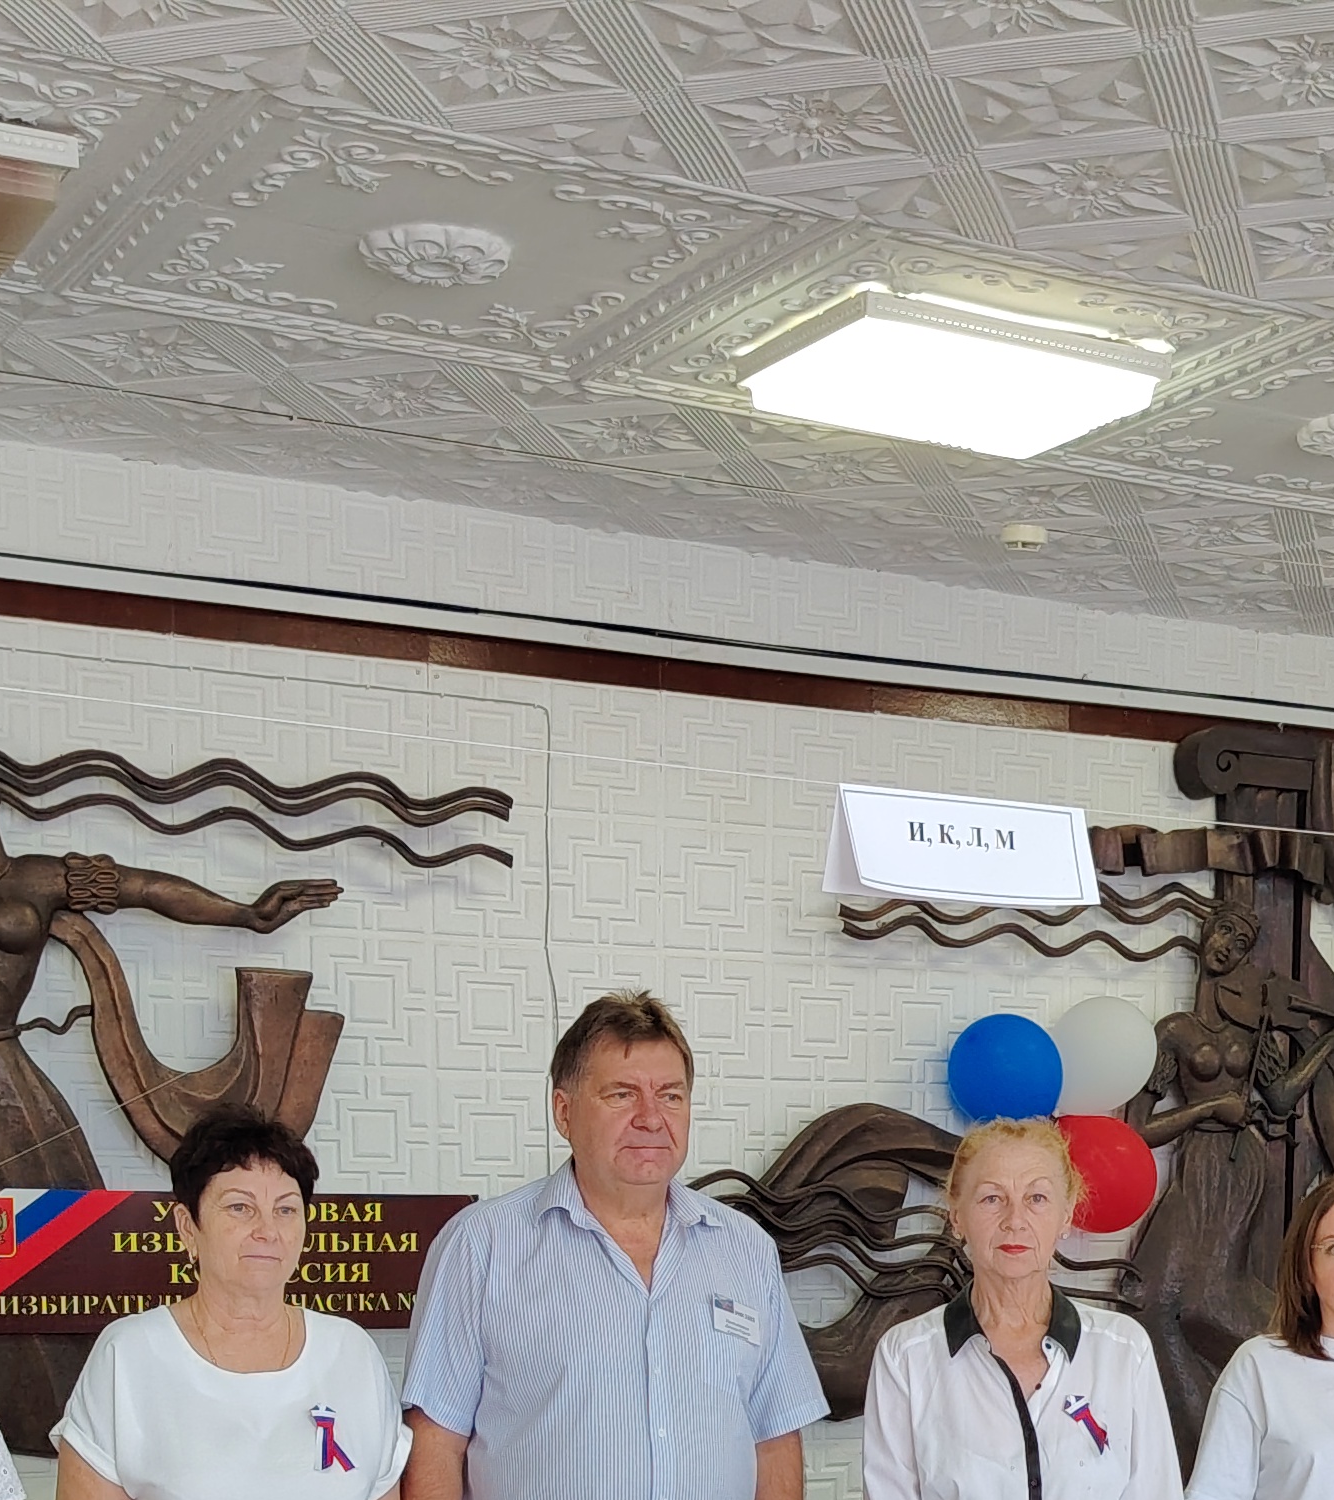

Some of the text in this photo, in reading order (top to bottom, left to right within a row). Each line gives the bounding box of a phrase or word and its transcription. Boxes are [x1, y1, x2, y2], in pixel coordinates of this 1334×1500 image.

[907, 820, 1016, 852] И, К, Л, М
[285, 1293, 392, 1312] ЧАСТКА
